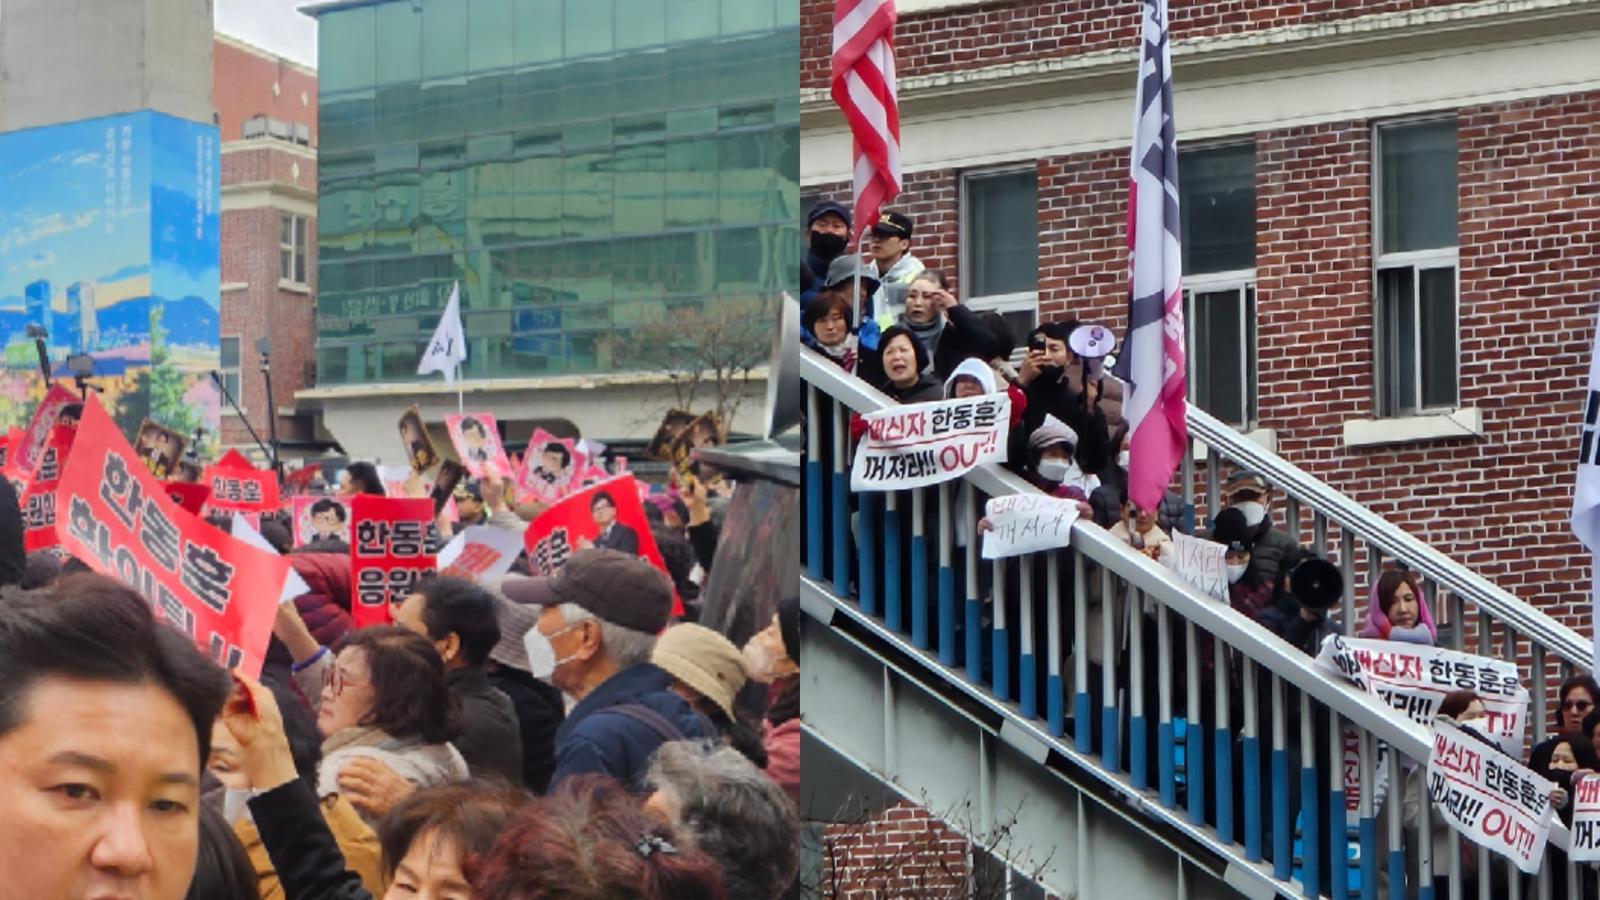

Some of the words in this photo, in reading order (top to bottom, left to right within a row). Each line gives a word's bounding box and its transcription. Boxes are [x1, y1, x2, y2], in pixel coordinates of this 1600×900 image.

[931, 401, 1003, 434] 한동훈
[864, 450, 937, 481] 꺼져라!!
[212, 475, 263, 502] 한동훈
[99, 449, 235, 614] 한동훈
[357, 567, 437, 605] 응원
[1429, 657, 1519, 697] 한동훈은
[1485, 758, 1549, 816] 한동훈은
[1481, 807, 1536, 861] OUT!!
